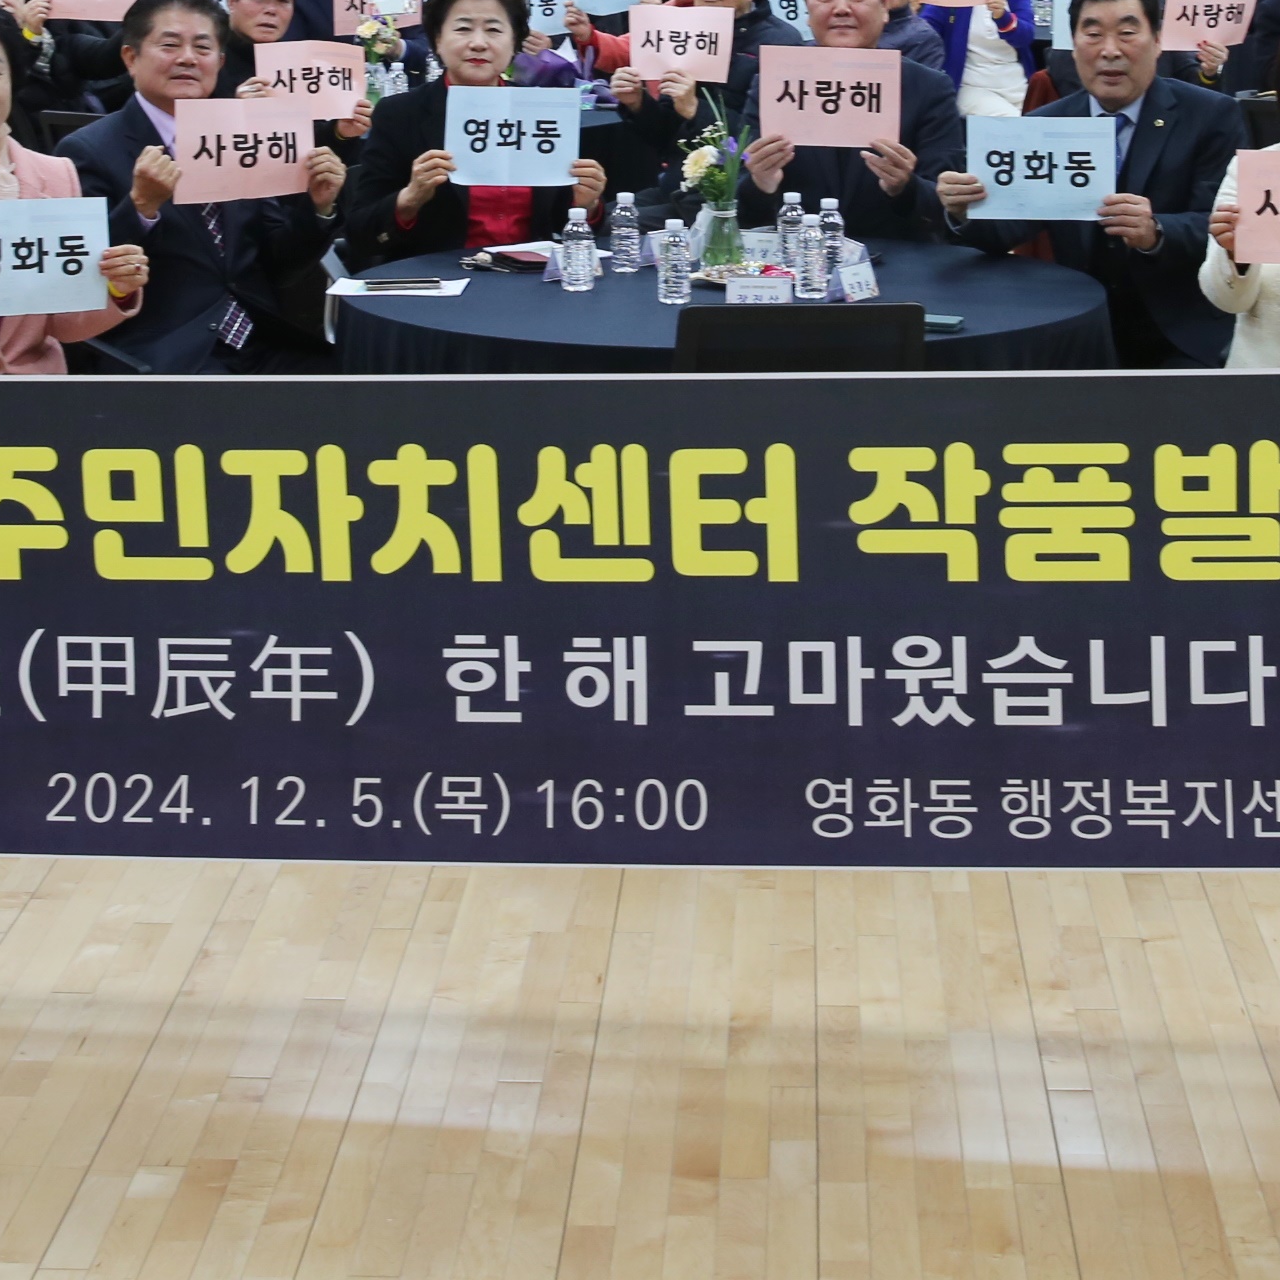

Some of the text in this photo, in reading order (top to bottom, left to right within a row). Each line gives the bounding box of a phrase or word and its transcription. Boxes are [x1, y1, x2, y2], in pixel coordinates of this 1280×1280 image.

[1176, 4, 1244, 28] 사랑해
[641, 30, 718, 55] 사랑해
[272, 67, 351, 94] 사랑해
[776, 80, 881, 114] 사랑해
[193, 132, 297, 168] 사랑해
[464, 119, 561, 154] 영화동
[986, 150, 1095, 187] 영화동
[443, 635, 531, 722] 한
[564, 636, 647, 725] 해
[46, 773, 210, 825] 2024.
[242, 776, 325, 827] 12.
[537, 779, 707, 830] 16:00
[806, 778, 978, 838] 영화동
